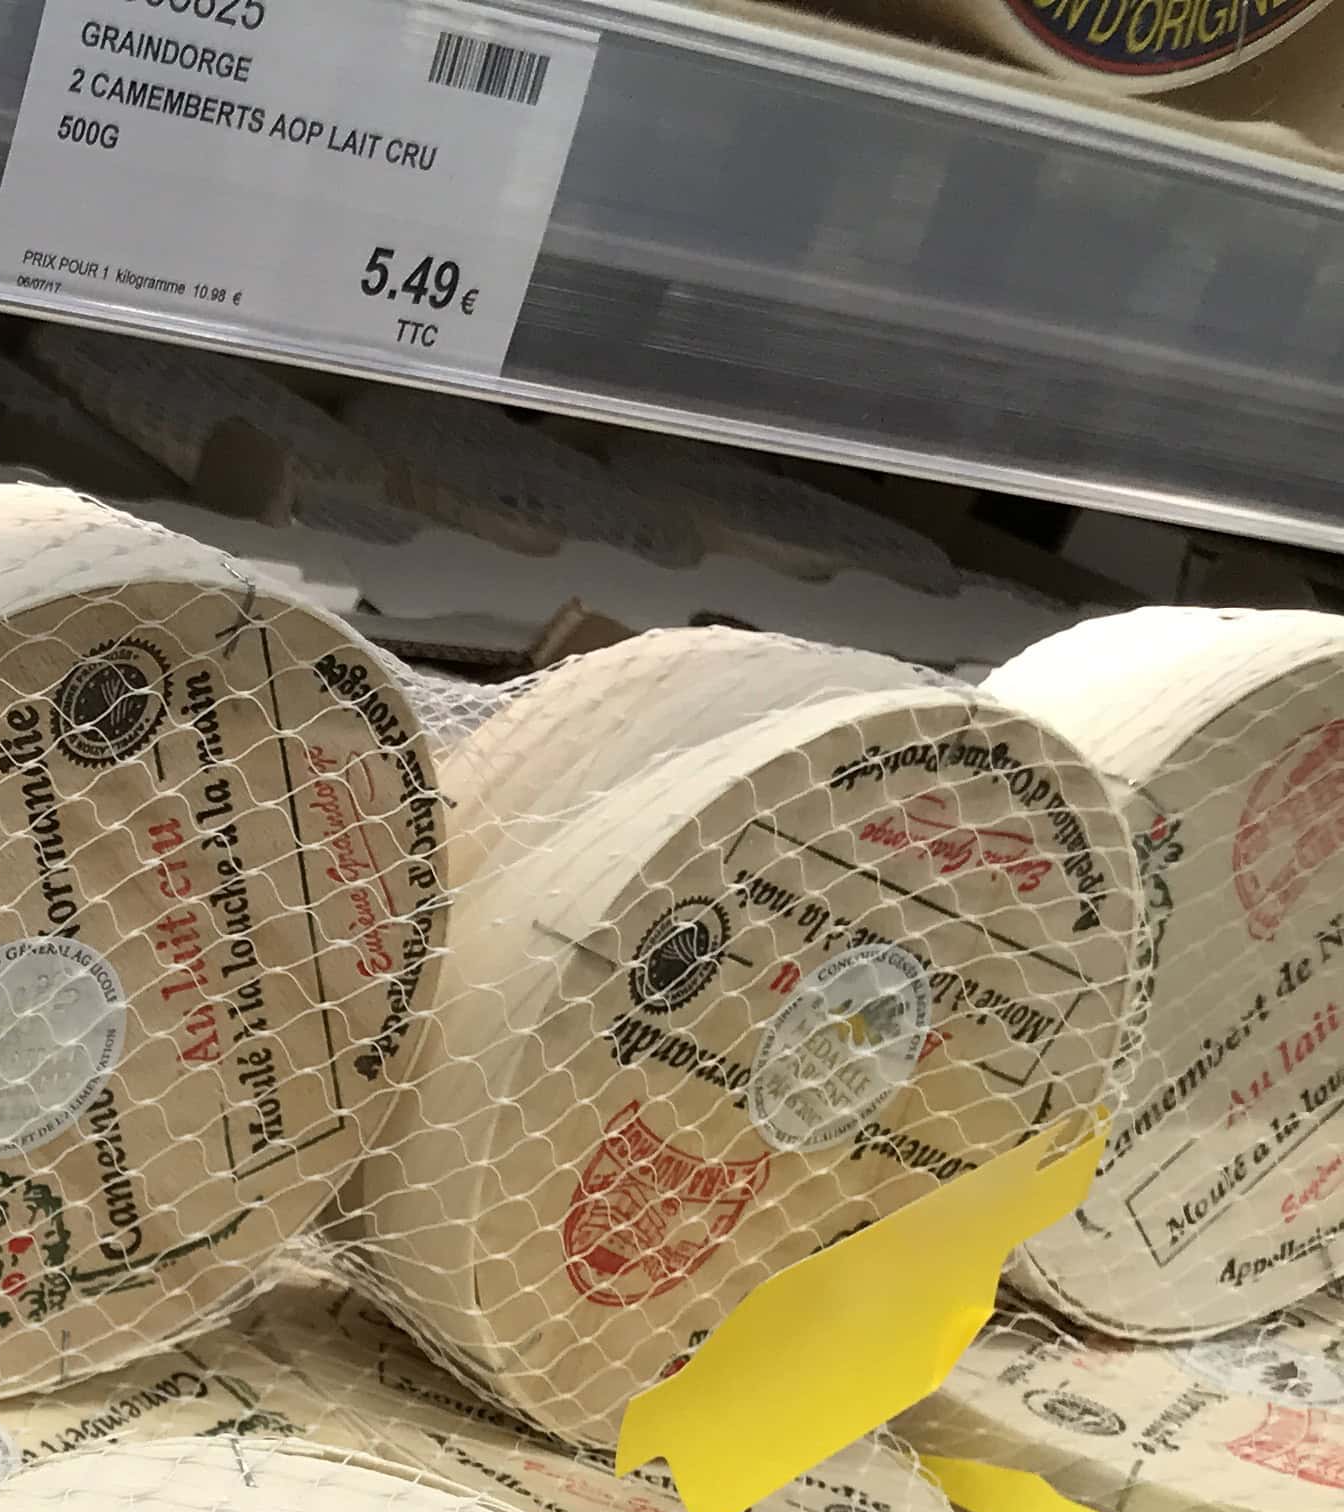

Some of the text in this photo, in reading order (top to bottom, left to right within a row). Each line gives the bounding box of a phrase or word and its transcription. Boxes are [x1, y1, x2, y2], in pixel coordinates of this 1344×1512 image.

[81, 21, 253, 83] GRAINDORGE
[57, 114, 120, 150] 500G
[69, 68, 438, 172] 2 CAMEMBERTS AOP LAIT CRU
[16, 276, 61, 296] 06/07/17
[22, 250, 57, 270] PRIX
[59, 255, 99, 279] POUR
[116, 269, 186, 297] kilogramme
[193, 284, 227, 304] 10.98
[232, 291, 243, 306] €
[360, 247, 479, 316] 5.49 €
[396, 320, 439, 348] TTC
[179, 670, 224, 775] main
[196, 778, 234, 824] la
[148, 817, 226, 1066] cru lait Au
[209, 855, 259, 979] louche
[228, 976, 265, 1021] la
[1274, 957, 1313, 1000] de
